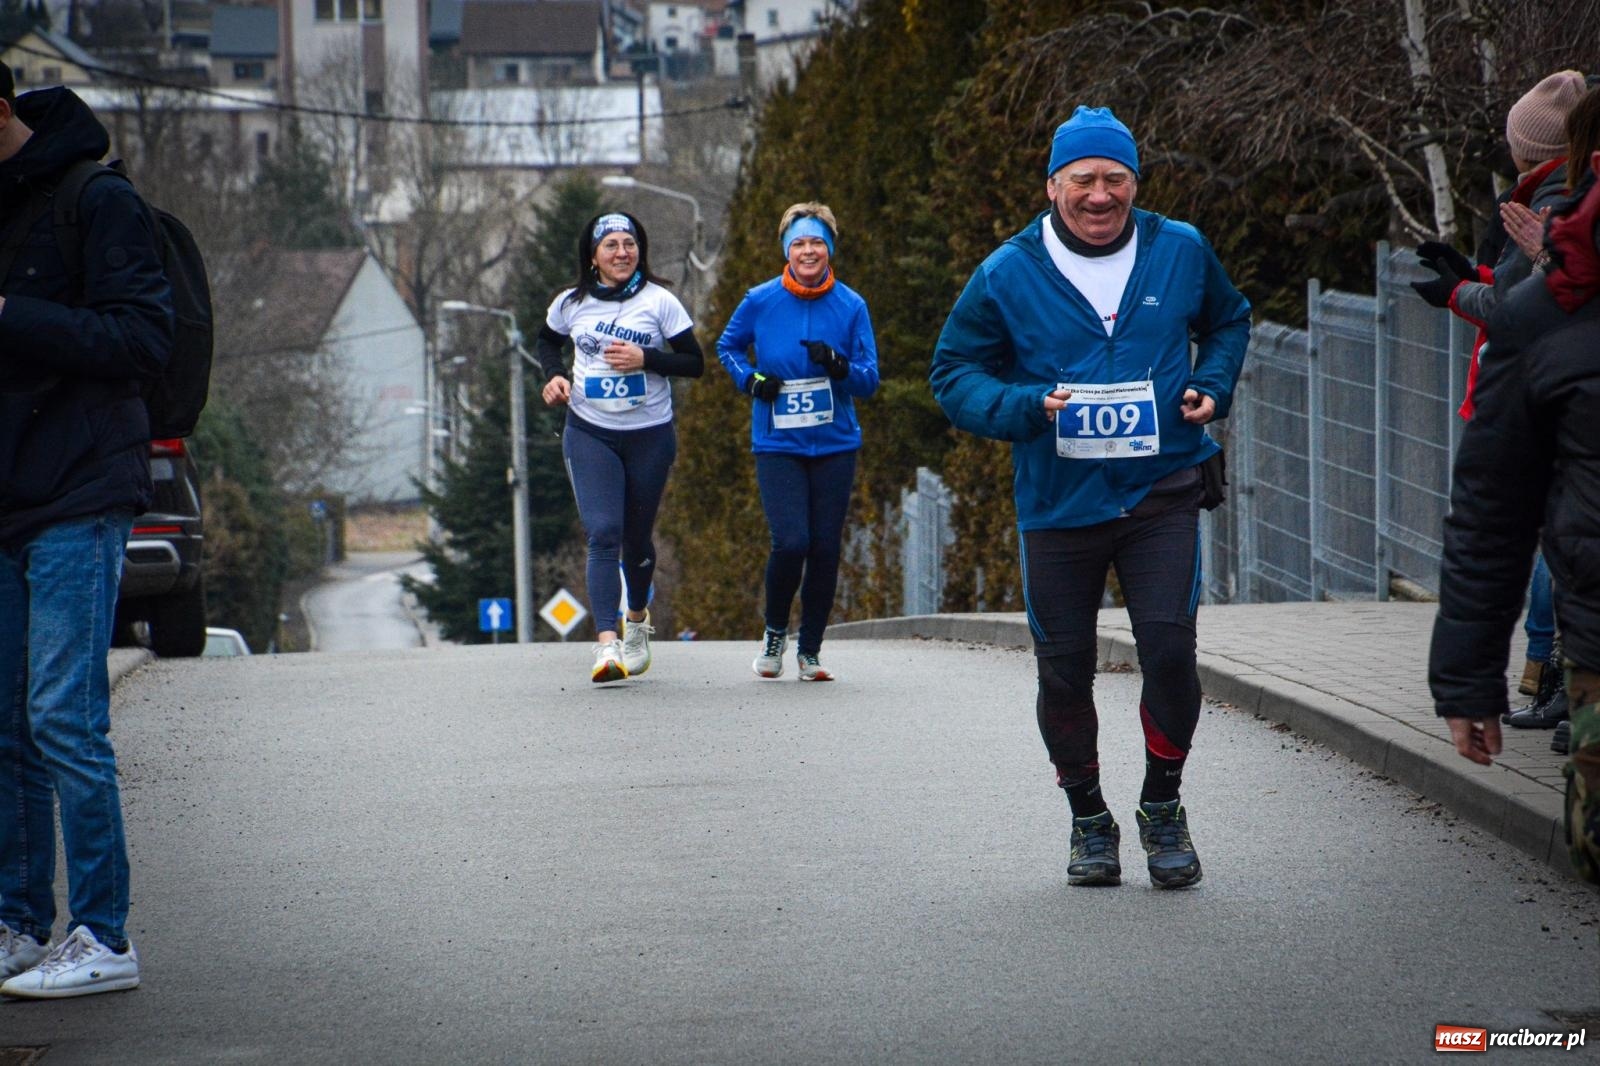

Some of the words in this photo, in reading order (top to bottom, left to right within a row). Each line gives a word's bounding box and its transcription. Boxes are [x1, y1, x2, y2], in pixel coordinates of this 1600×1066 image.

[600, 377, 629, 398] 96
[787, 392, 814, 413] 55
[1075, 403, 1140, 436] 109
